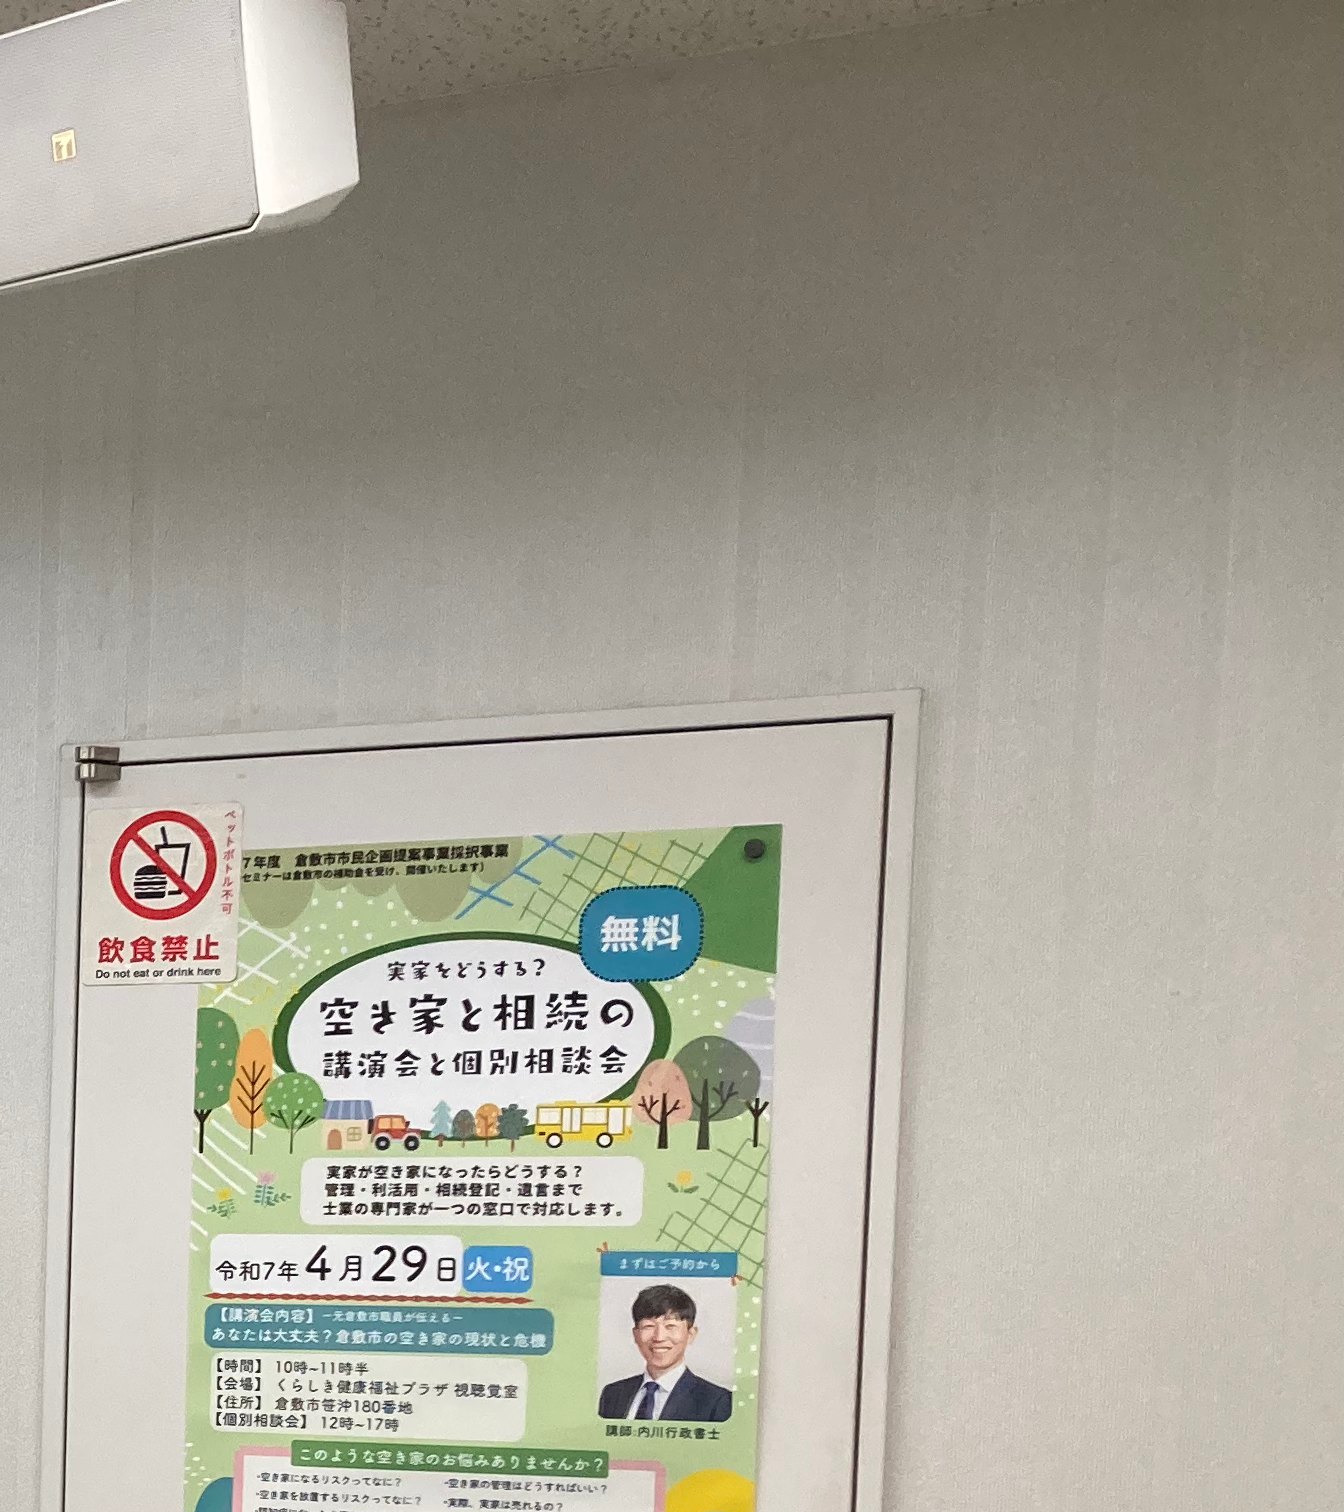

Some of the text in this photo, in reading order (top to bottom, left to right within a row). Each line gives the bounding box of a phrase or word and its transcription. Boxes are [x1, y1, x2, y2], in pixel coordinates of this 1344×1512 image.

[221, 809, 237, 915] ペットボトル不可
[98, 934, 220, 964] 飲食禁止
[599, 914, 682, 953] 無料
[96, 970, 110, 979] Do
[113, 969, 131, 978] not
[134, 969, 150, 978] eat
[166, 967, 194, 977] drink
[197, 967, 221, 976] here
[319, 991, 634, 1036] 空き家と相続の
[322, 1045, 628, 1079] 講演会と個別相談会
[322, 1201, 622, 1217] 士業の専門家が一つの窓口で対応します。
[619, 1257, 721, 1271] まずはご予約から
